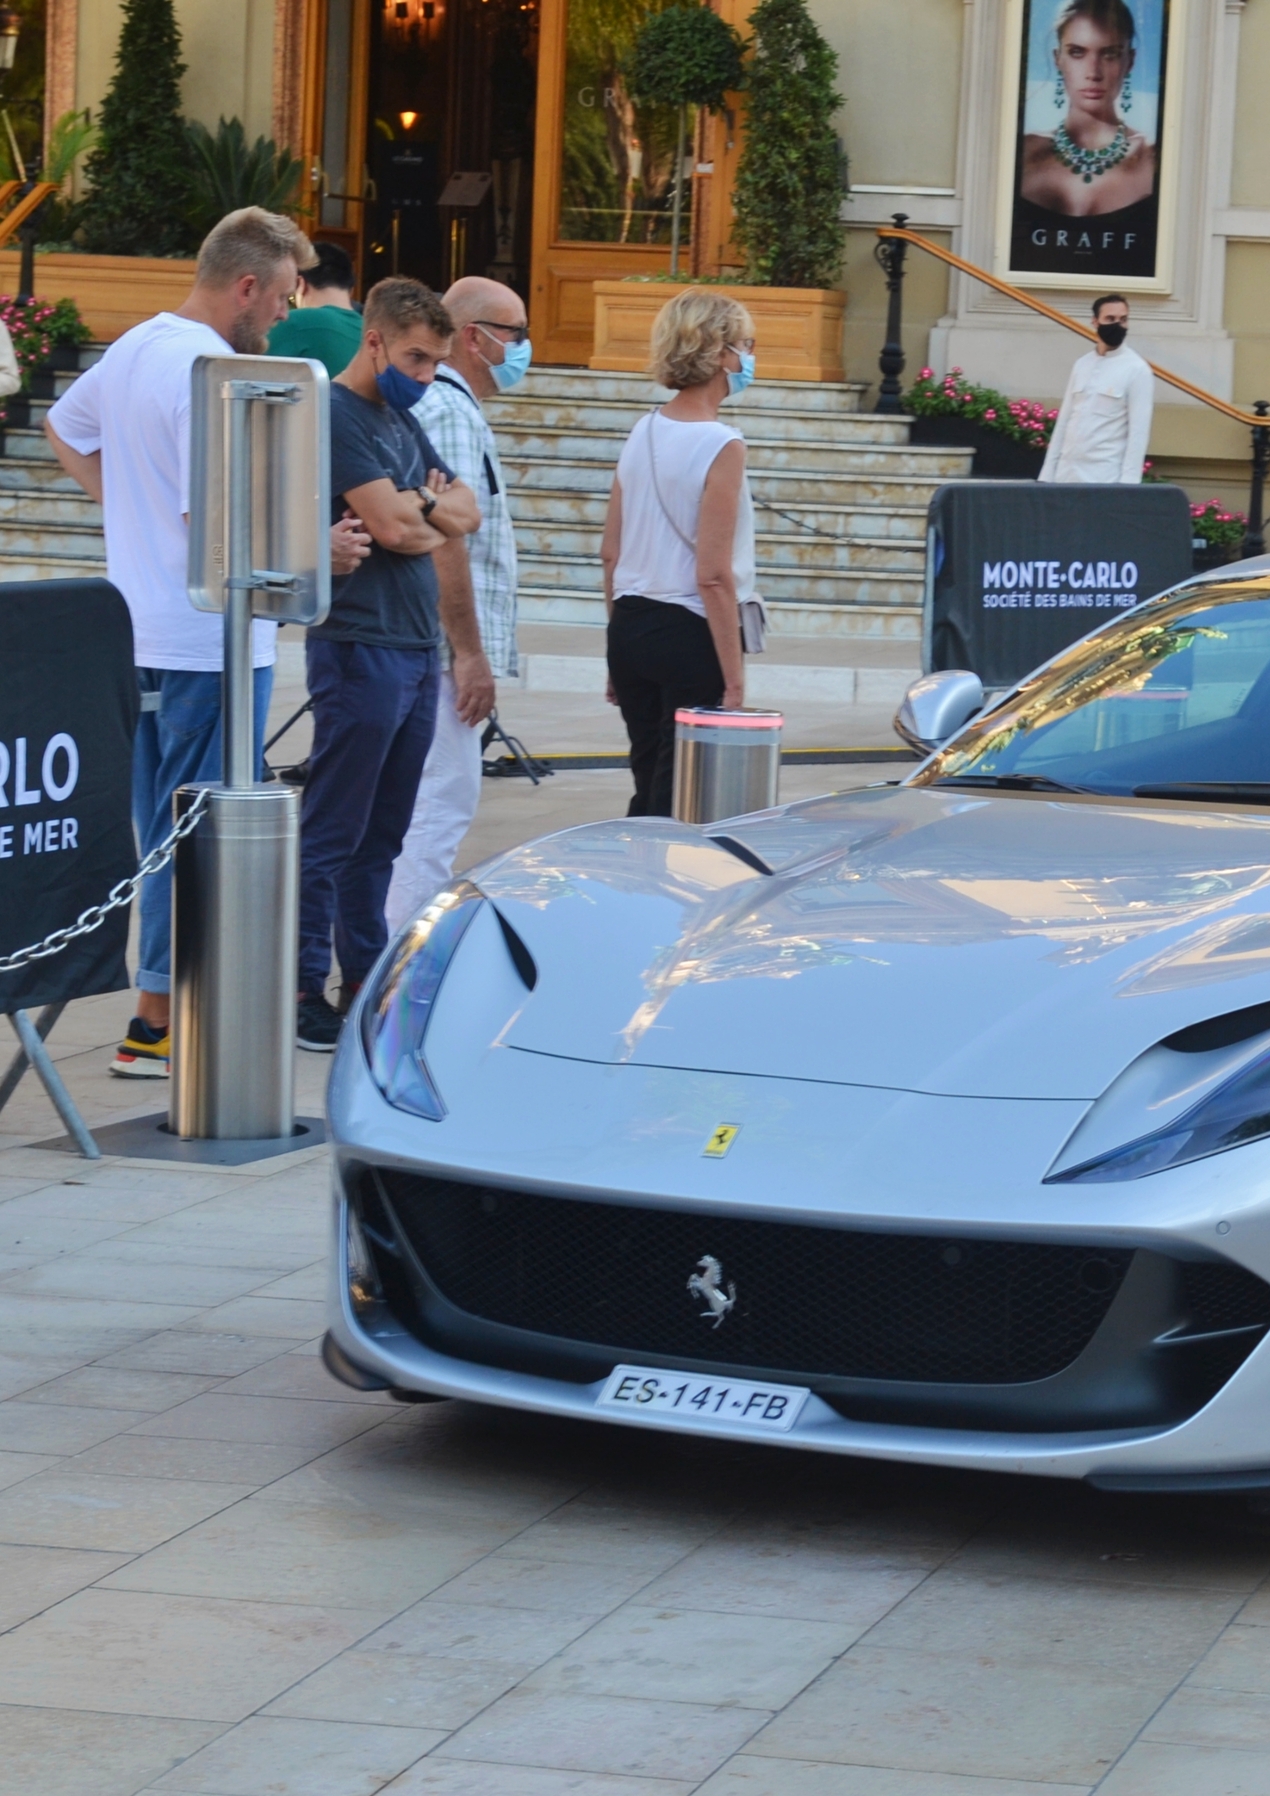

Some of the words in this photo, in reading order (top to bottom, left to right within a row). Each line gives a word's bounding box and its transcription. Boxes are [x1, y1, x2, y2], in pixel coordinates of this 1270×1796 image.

[1031, 228, 1137, 250] GRAFF
[983, 591, 1031, 608] SOCIÉTÉ
[1034, 594, 1057, 607] DES
[1059, 594, 1094, 607] BAINS
[1096, 594, 1111, 607] DE
[1113, 594, 1138, 607] MER
[23, 817, 79, 855] MER
[613, 1376, 789, 1421] ES-141-FB
